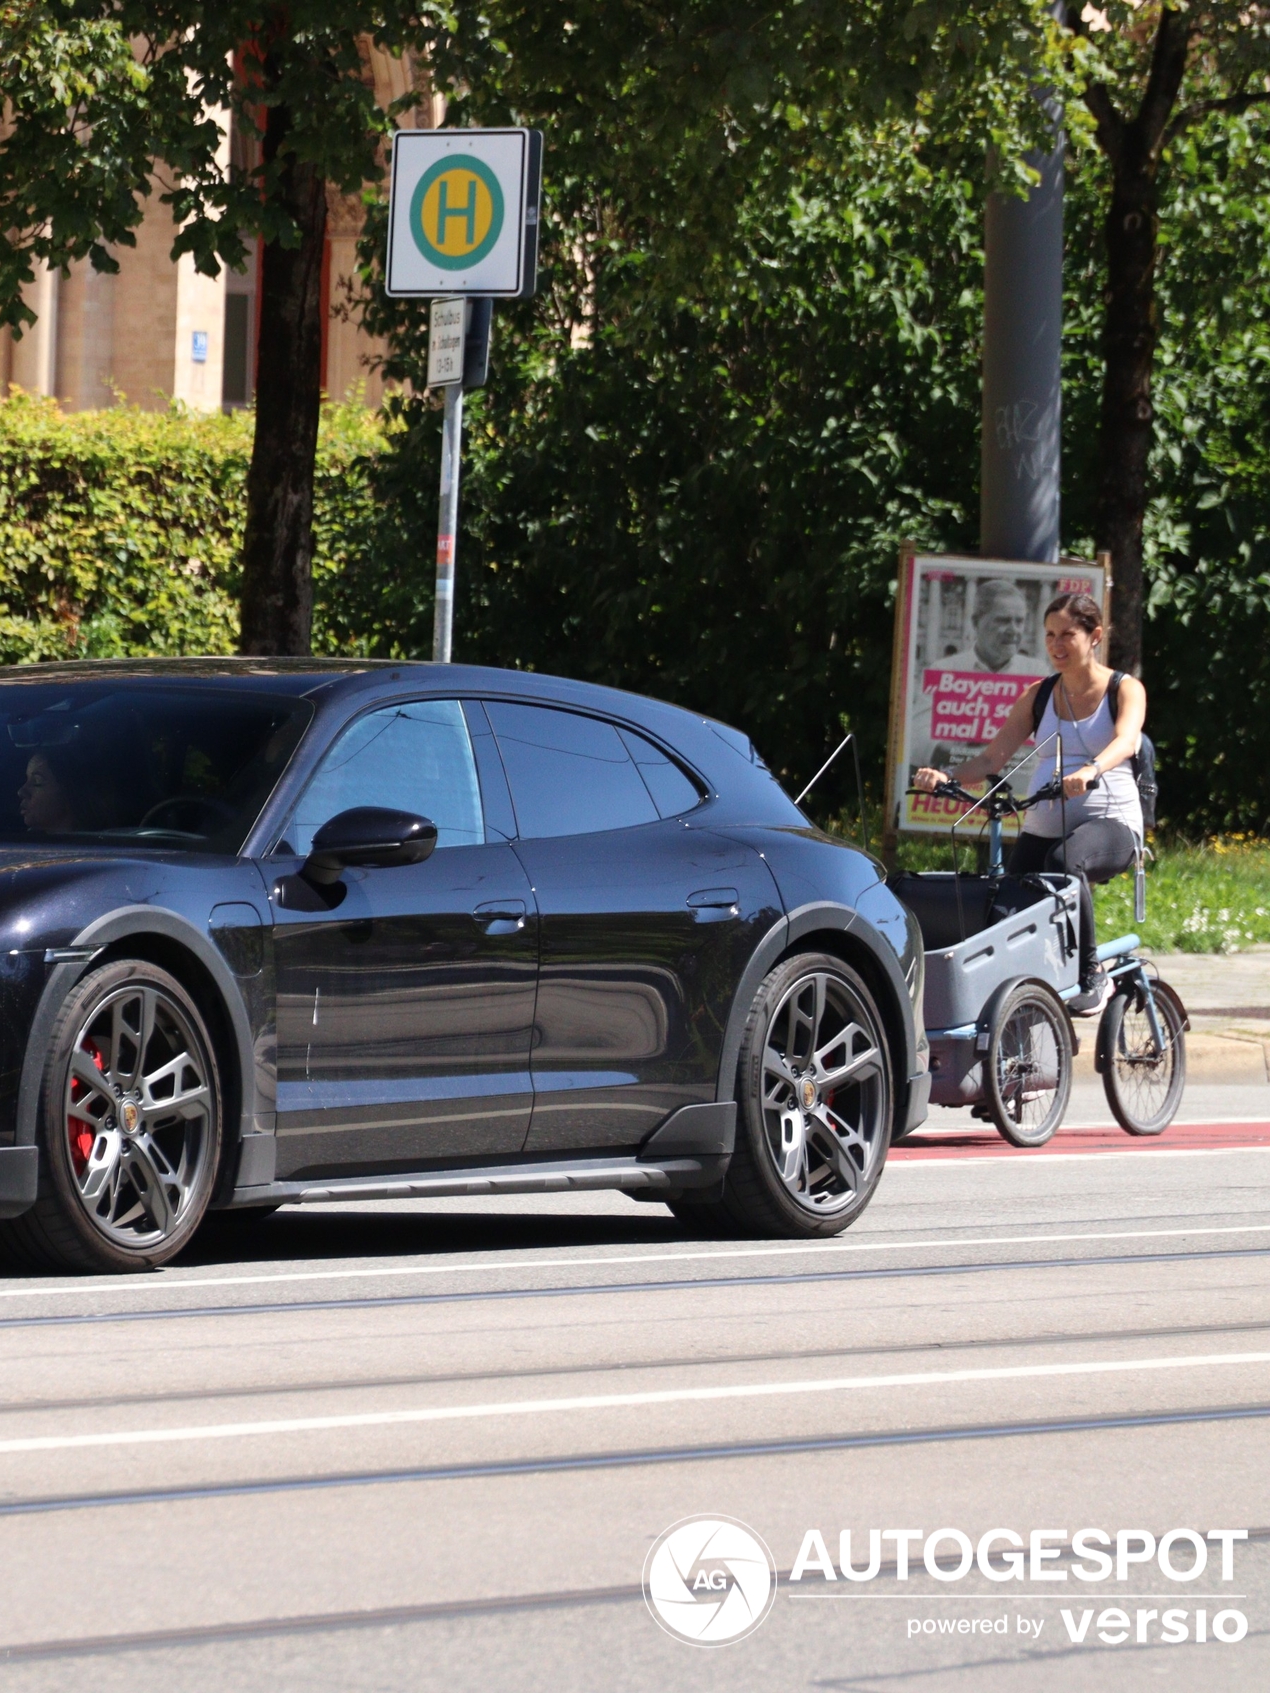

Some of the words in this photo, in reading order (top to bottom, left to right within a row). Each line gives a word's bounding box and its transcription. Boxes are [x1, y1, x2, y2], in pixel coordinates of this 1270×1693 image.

[436, 180, 477, 245] H
[1058, 578, 1091, 592] FDP
[936, 697, 989, 717] auch
[935, 719, 979, 738] mal
